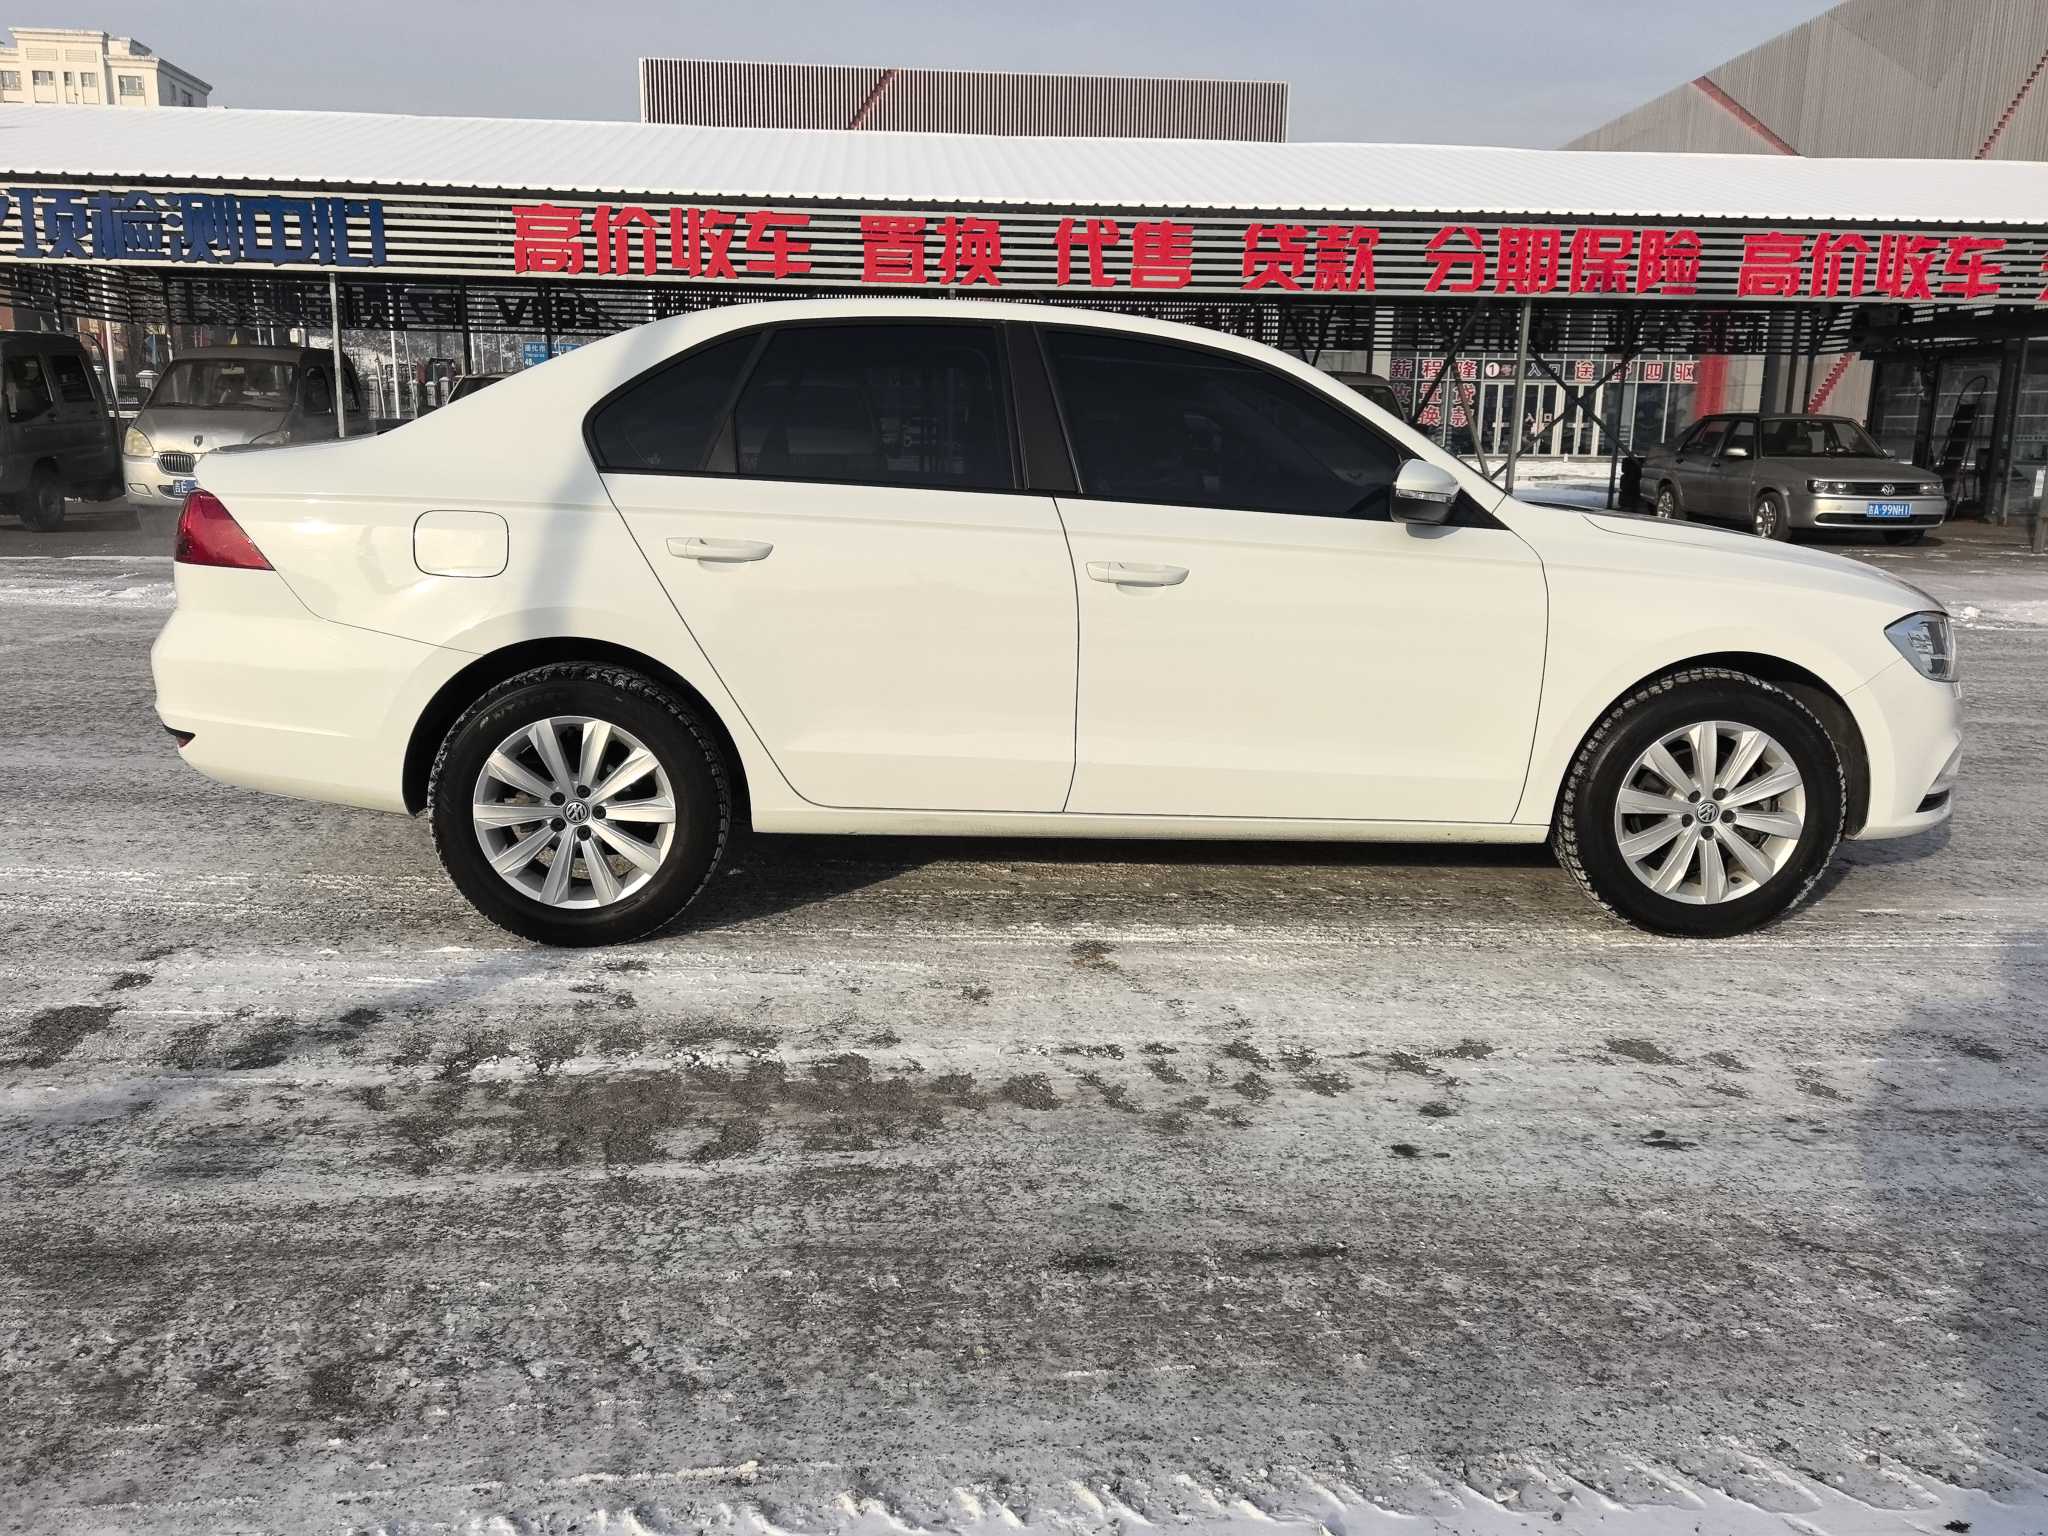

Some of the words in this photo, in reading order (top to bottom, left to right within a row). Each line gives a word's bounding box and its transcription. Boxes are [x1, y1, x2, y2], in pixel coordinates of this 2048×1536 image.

[0, 186, 387, 267] 项检测中心
[511, 202, 813, 280] 高价收车
[860, 215, 1003, 287] 置换
[1054, 217, 1193, 288] 代售
[1241, 223, 1380, 292] 贷款
[1424, 225, 1702, 295] 分期保险
[1737, 231, 2007, 300] 高价收车
